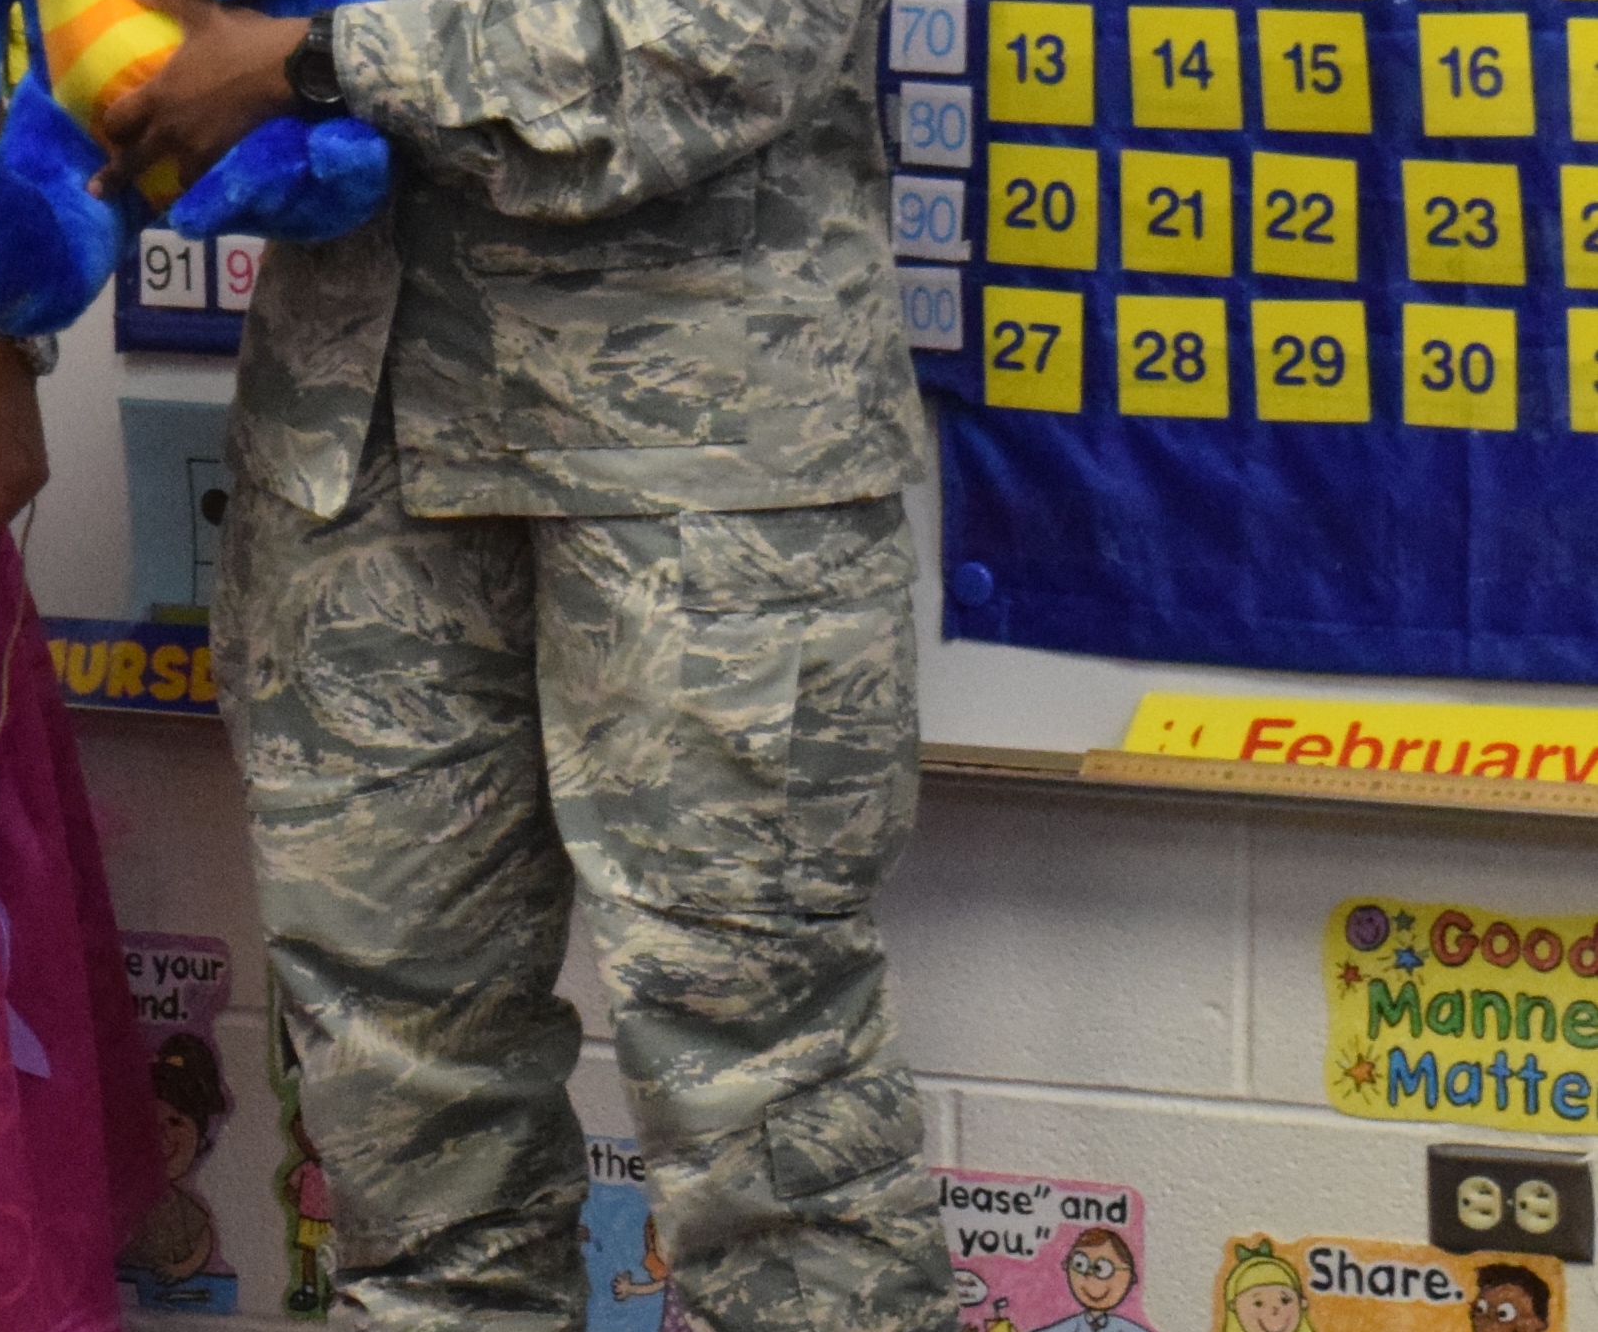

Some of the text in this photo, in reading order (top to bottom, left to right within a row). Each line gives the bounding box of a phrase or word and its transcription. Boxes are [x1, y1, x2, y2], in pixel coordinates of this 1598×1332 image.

[899, 5, 955, 57] 70
[1006, 33, 1503, 98] 13 14 15 16
[908, 99, 967, 152] 80
[899, 191, 957, 244] 90
[1005, 178, 1498, 248] 20 21 22 23
[145, 244, 193, 293] 91
[992, 320, 1494, 394] 27 28 29 30
[1430, 909, 1598, 977] Good
[153, 955, 224, 985] your
[1368, 978, 1598, 1050] Manne
[1387, 1047, 1598, 1121] Matte
[590, 1143, 646, 1182] the
[939, 1177, 1127, 1224] lease" and
[1307, 1248, 1465, 1302] Share.
